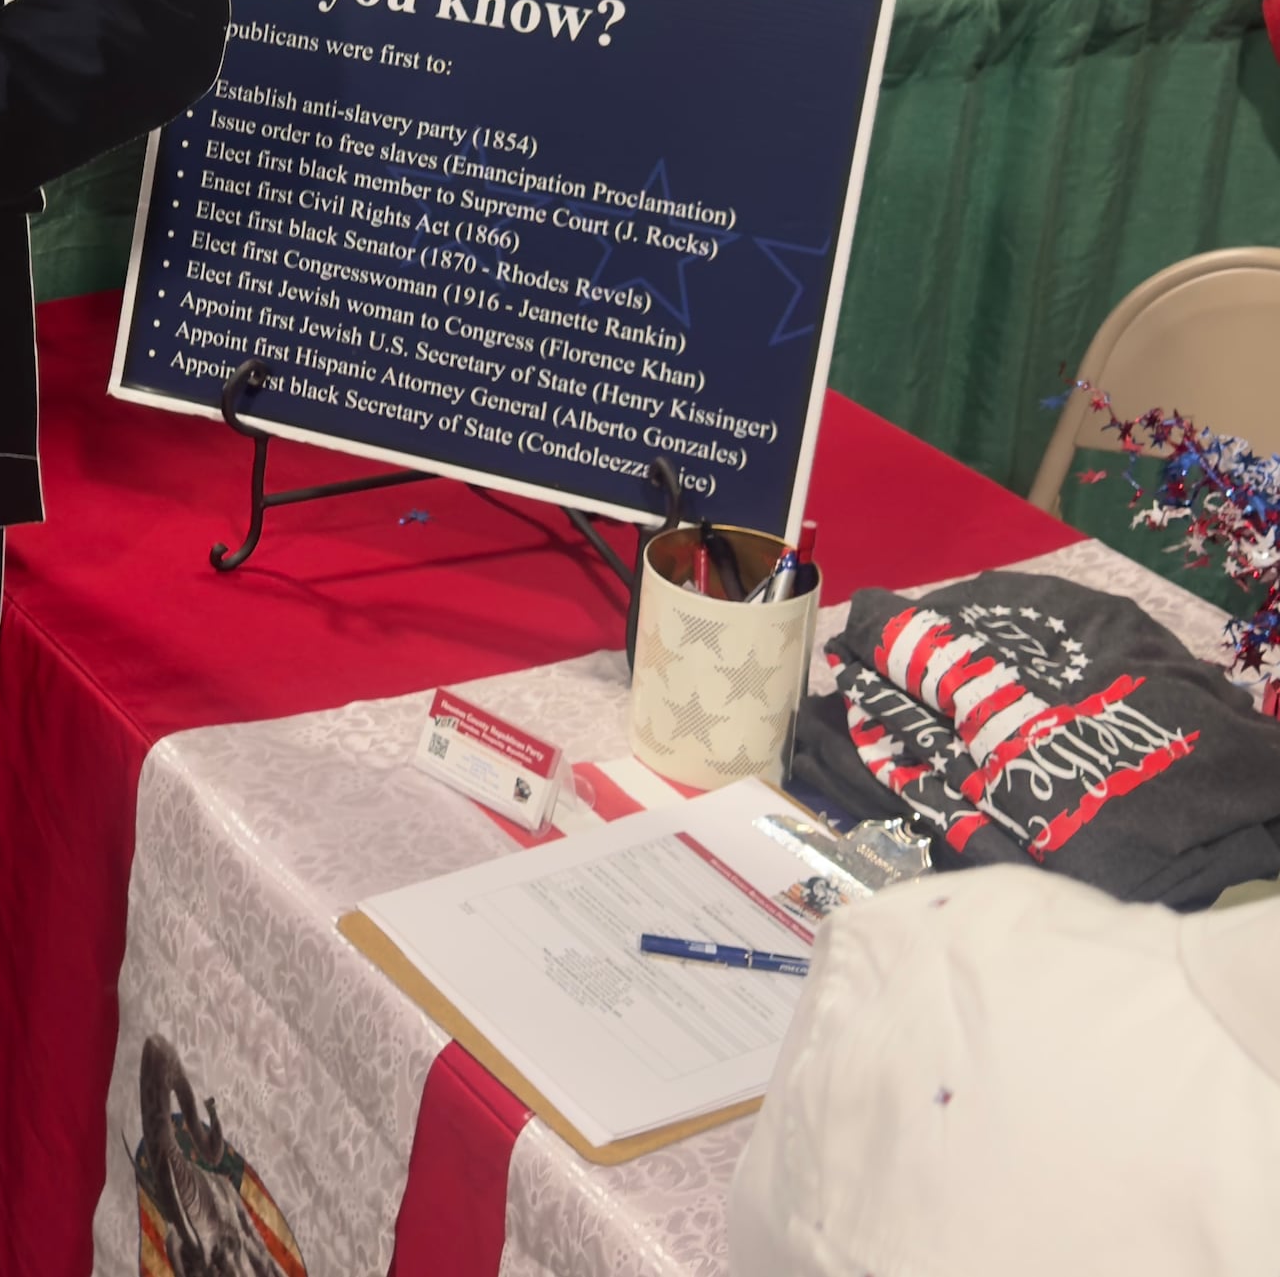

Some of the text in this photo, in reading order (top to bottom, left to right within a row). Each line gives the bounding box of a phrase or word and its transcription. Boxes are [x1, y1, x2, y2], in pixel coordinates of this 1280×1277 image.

[325, 39, 374, 61] were
[379, 43, 420, 70] first
[425, 54, 452, 75] to:
[210, 108, 736, 230] Issue order to free slaves (Emancipation Proclamation)
[214, 79, 537, 159] Establish anti-slavery party (1854)
[195, 199, 241, 226] Elect
[246, 210, 283, 235] first
[288, 217, 337, 246] black
[342, 229, 416, 261] Senator
[419, 246, 477, 274] (1870
[495, 260, 569, 294] Rhodes
[574, 276, 652, 314] Revels)
[200, 169, 520, 254] Enact first Civil Rights Act (1866)
[205, 139, 718, 261] Elect first black member to Supreme Court (J. Rocks)
[186, 259, 705, 393] Elect first Jewish woman to Congress (Florence Khan)
[191, 229, 236, 256] Elect
[241, 239, 278, 265] first
[283, 249, 437, 299] Congresswoman
[442, 283, 499, 311] (1916
[517, 298, 599, 333] Jeanette
[603, 316, 686, 355] Rankin)
[174, 320, 747, 470] Appoint first Hispanic Attorney General (Alberto Gonzales)
[179, 290, 778, 444] Appoint first Jewish U.S. Secretary of State (Henry Kissinger)
[289, 375, 339, 405] black
[344, 388, 434, 430] Secretary
[437, 413, 463, 430] of
[464, 418, 513, 446] State
[677, 465, 717, 498] ice)
[865, 688, 952, 747] 1776
